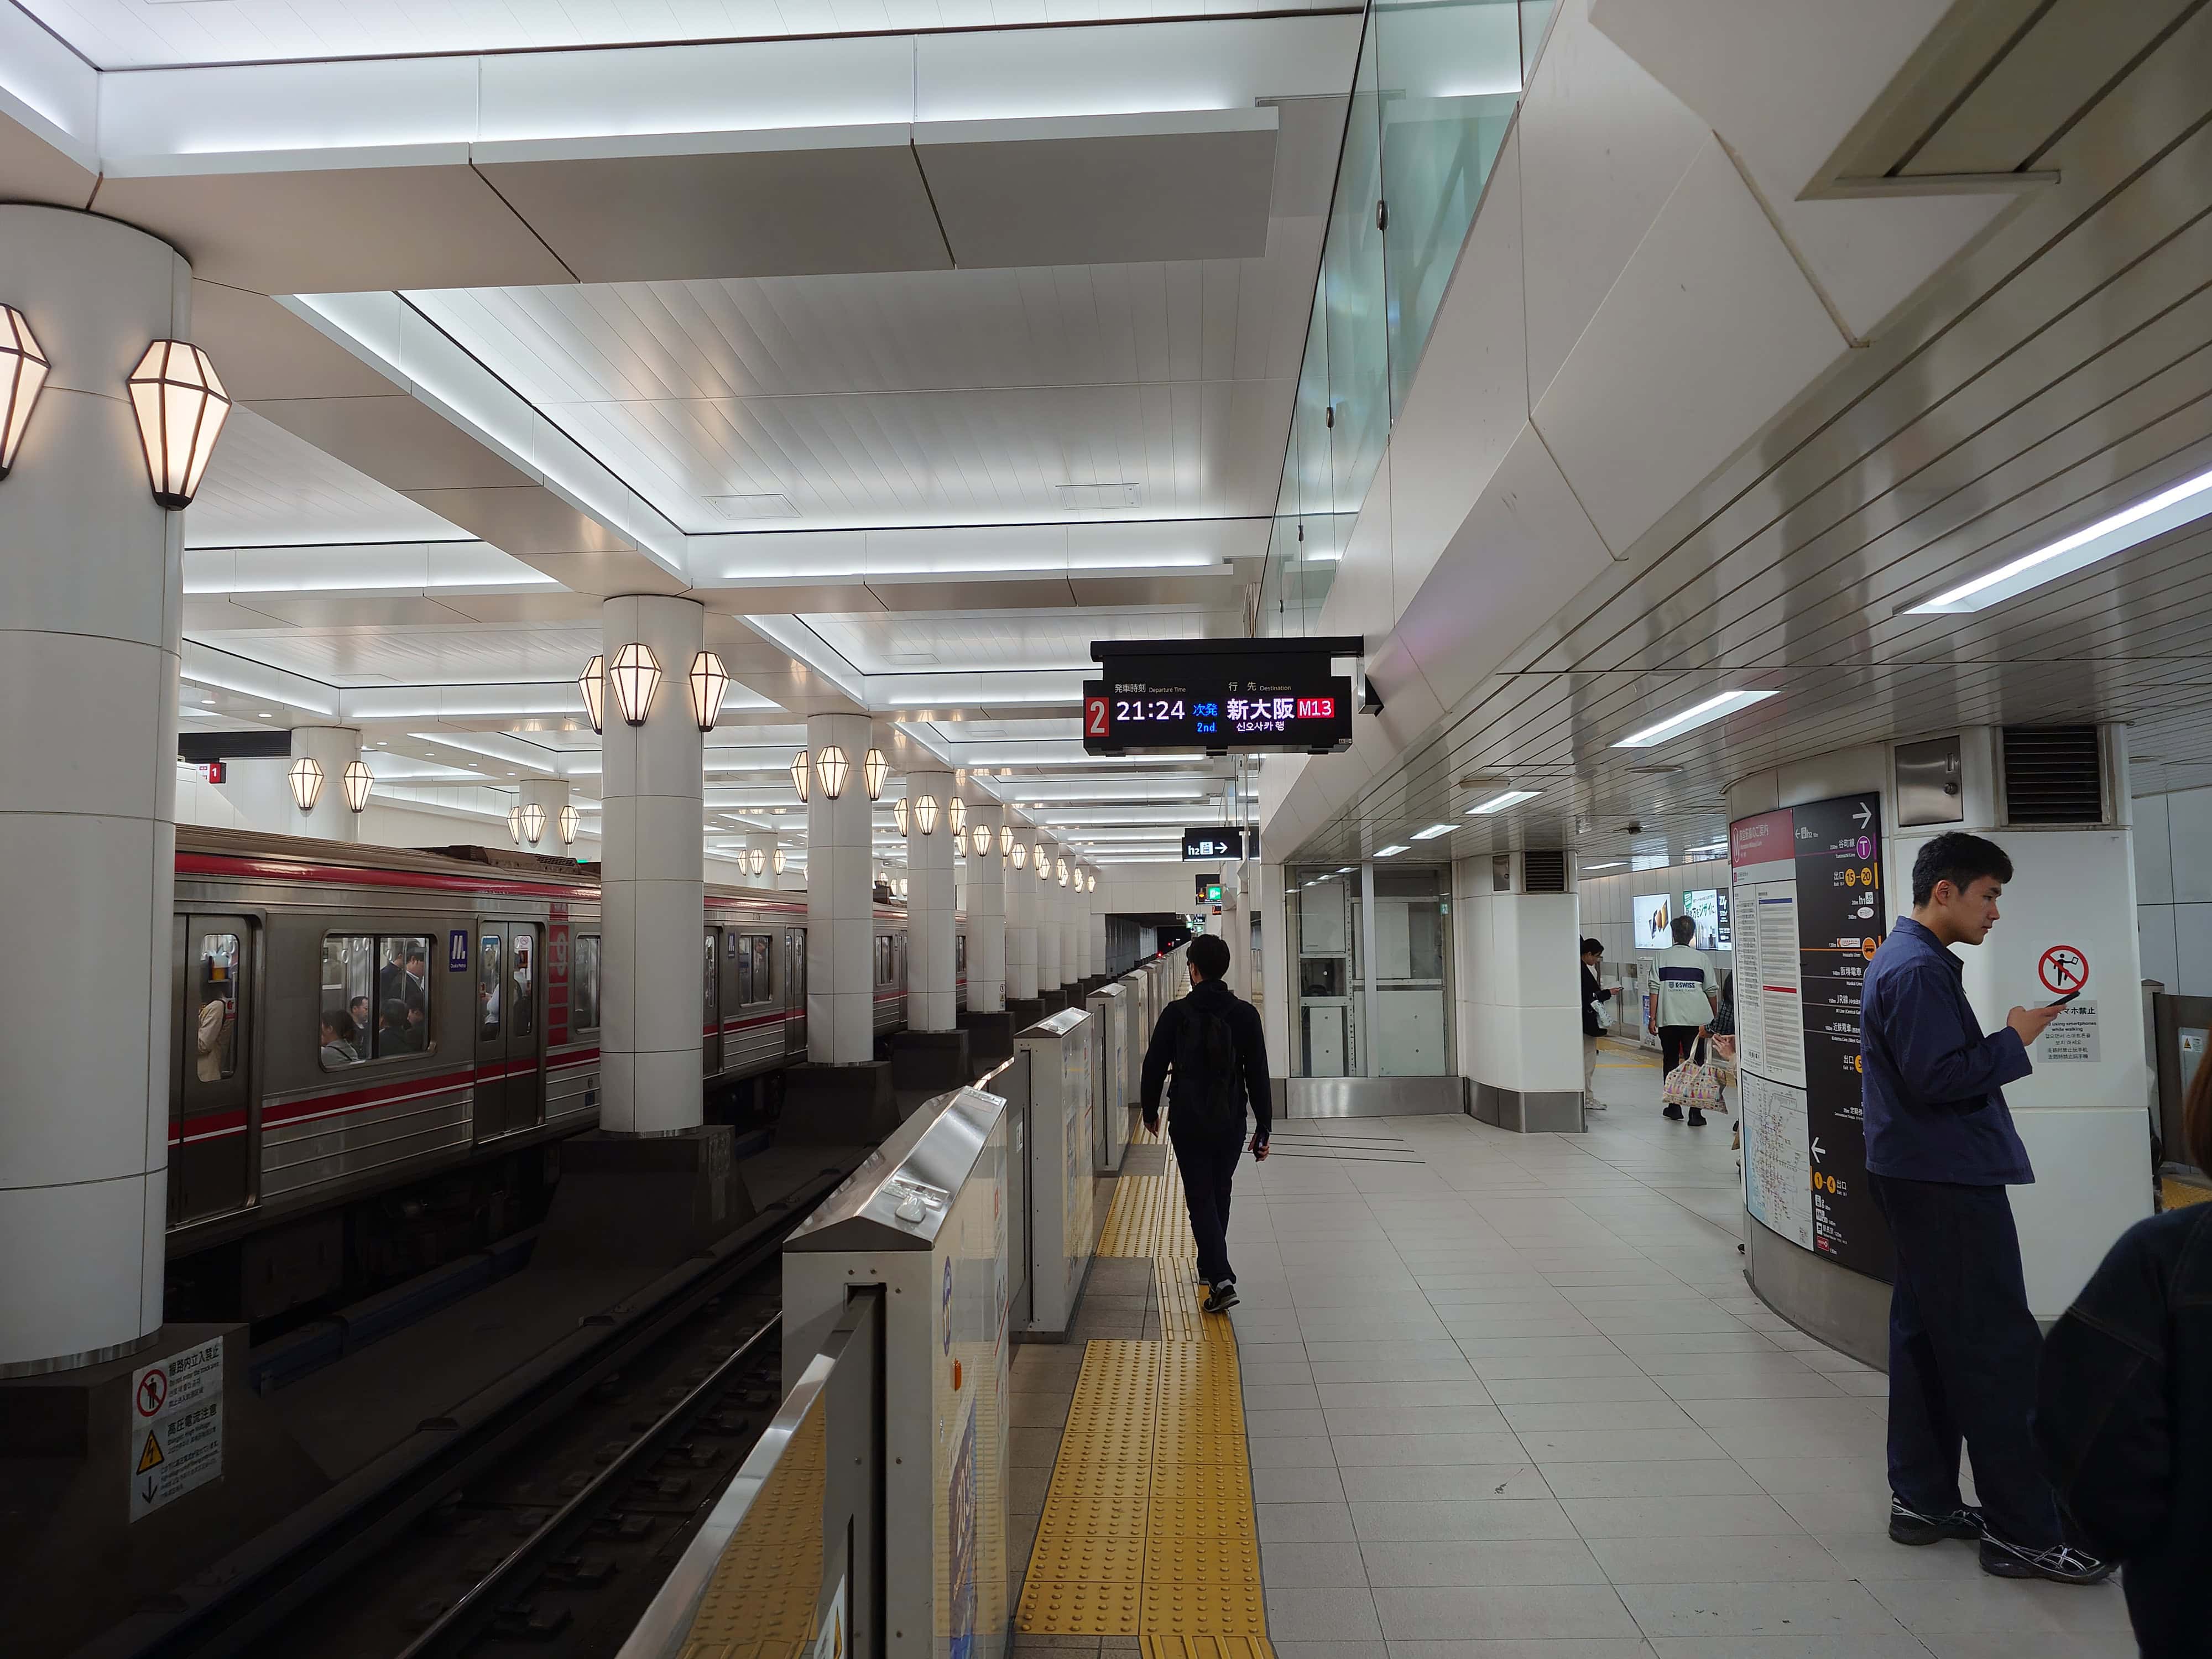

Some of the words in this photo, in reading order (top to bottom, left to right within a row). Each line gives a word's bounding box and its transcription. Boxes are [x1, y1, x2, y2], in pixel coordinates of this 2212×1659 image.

[1114, 684, 1146, 693] 発車時刻
[1117, 701, 1185, 721] 21:24
[1192, 703, 1218, 717] 次発
[1227, 698, 1295, 721] 新大阪
[1299, 700, 1332, 717] M13
[1090, 701, 1105, 733] 2
[1197, 722, 1217, 732] 2nd.
[1237, 722, 1274, 732] 신오사카
[1275, 721, 1285, 732] 행
[212, 768, 217, 777] 1
[1839, 838, 1855, 848] 谷町線
[1859, 840, 1867, 855] T
[1188, 846, 1200, 855] h2
[1834, 872, 1844, 880] 出口
[1847, 873, 1854, 882] 15
[1863, 872, 1870, 881] 20
[1837, 995, 1848, 1004] JR線
[1833, 1022, 1851, 1032] 近鉄電車
[1844, 1055, 1854, 1064] 出口
[1830, 1180, 1834, 1190] 4
[1837, 1179, 1846, 1191] 出口
[169, 1344, 220, 1376] 線路内立入禁止
